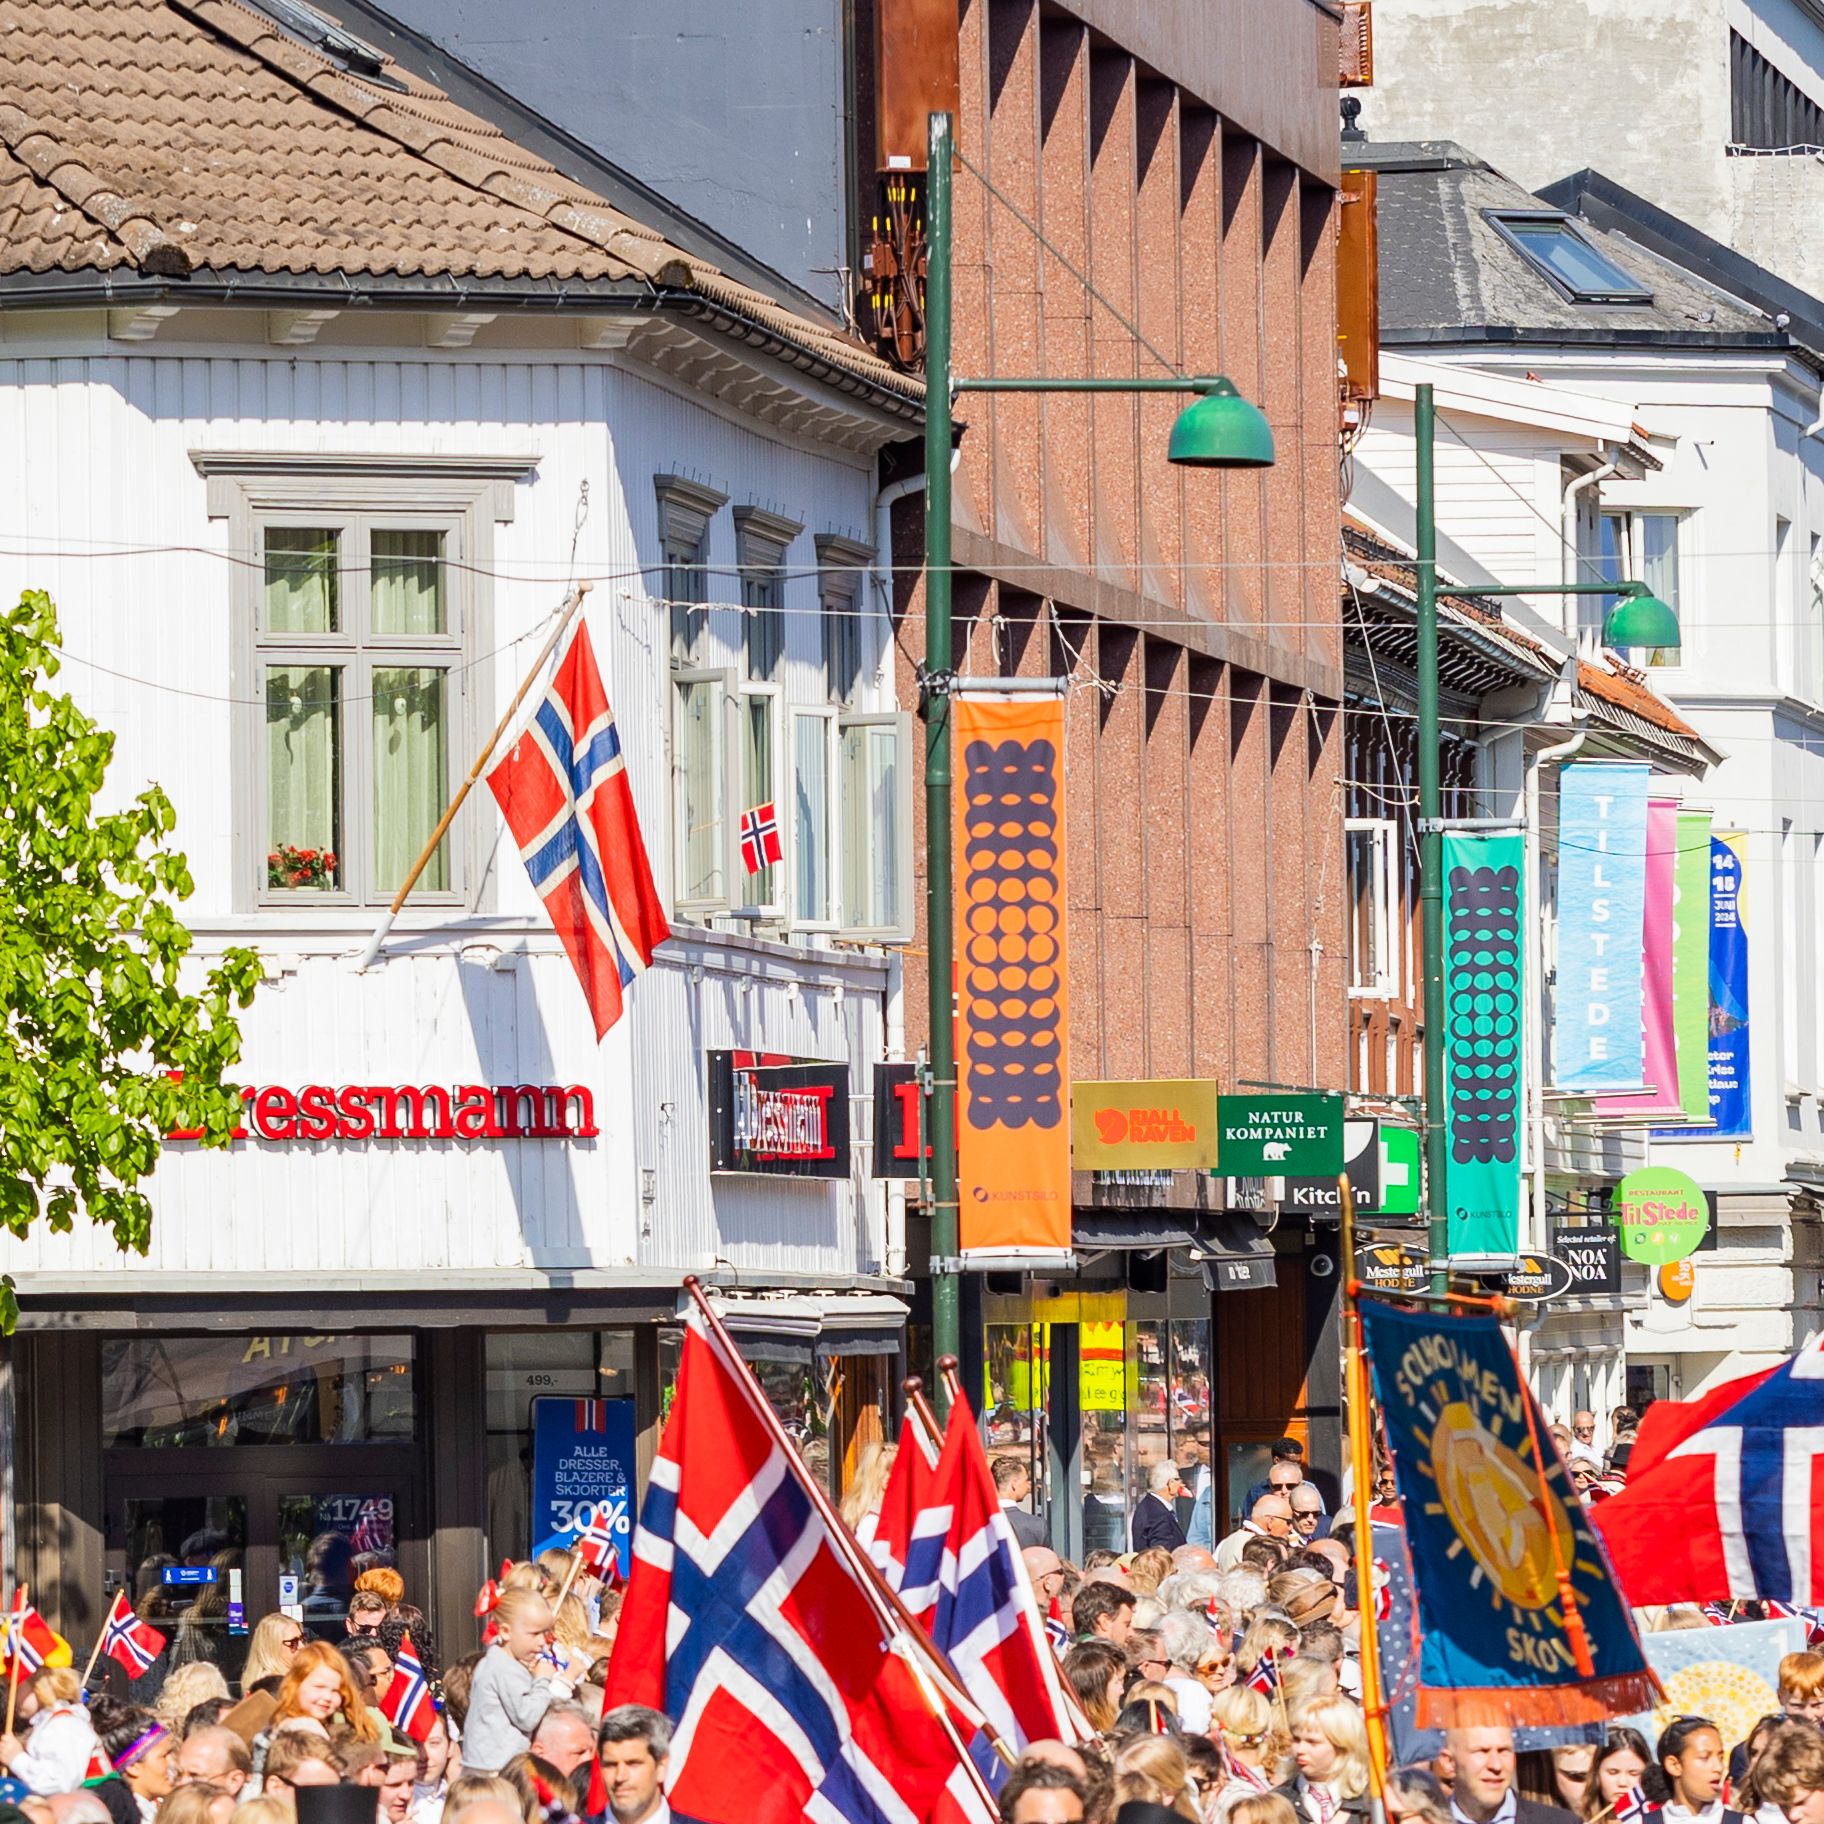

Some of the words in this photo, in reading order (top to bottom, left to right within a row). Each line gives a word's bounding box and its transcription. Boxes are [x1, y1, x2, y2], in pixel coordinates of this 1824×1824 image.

[1715, 912, 1736, 922] 2024
[1587, 795, 1614, 1061] TILSTEDE
[1248, 1112, 1304, 1123] NATUR
[1226, 1126, 1328, 1140] KOMPANIET
[1568, 1265, 1607, 1281] NOA
[526, 1375, 559, 1387] 499,-
[574, 1447, 608, 1457] ALLE
[559, 1460, 623, 1471] DRESSER,
[555, 1472, 613, 1483] BLAZERE
[616, 1472, 626, 1483] &
[555, 1485, 626, 1496] SKJORTER
[332, 1499, 394, 1520] 1749
[550, 1500, 630, 1534] 30%
